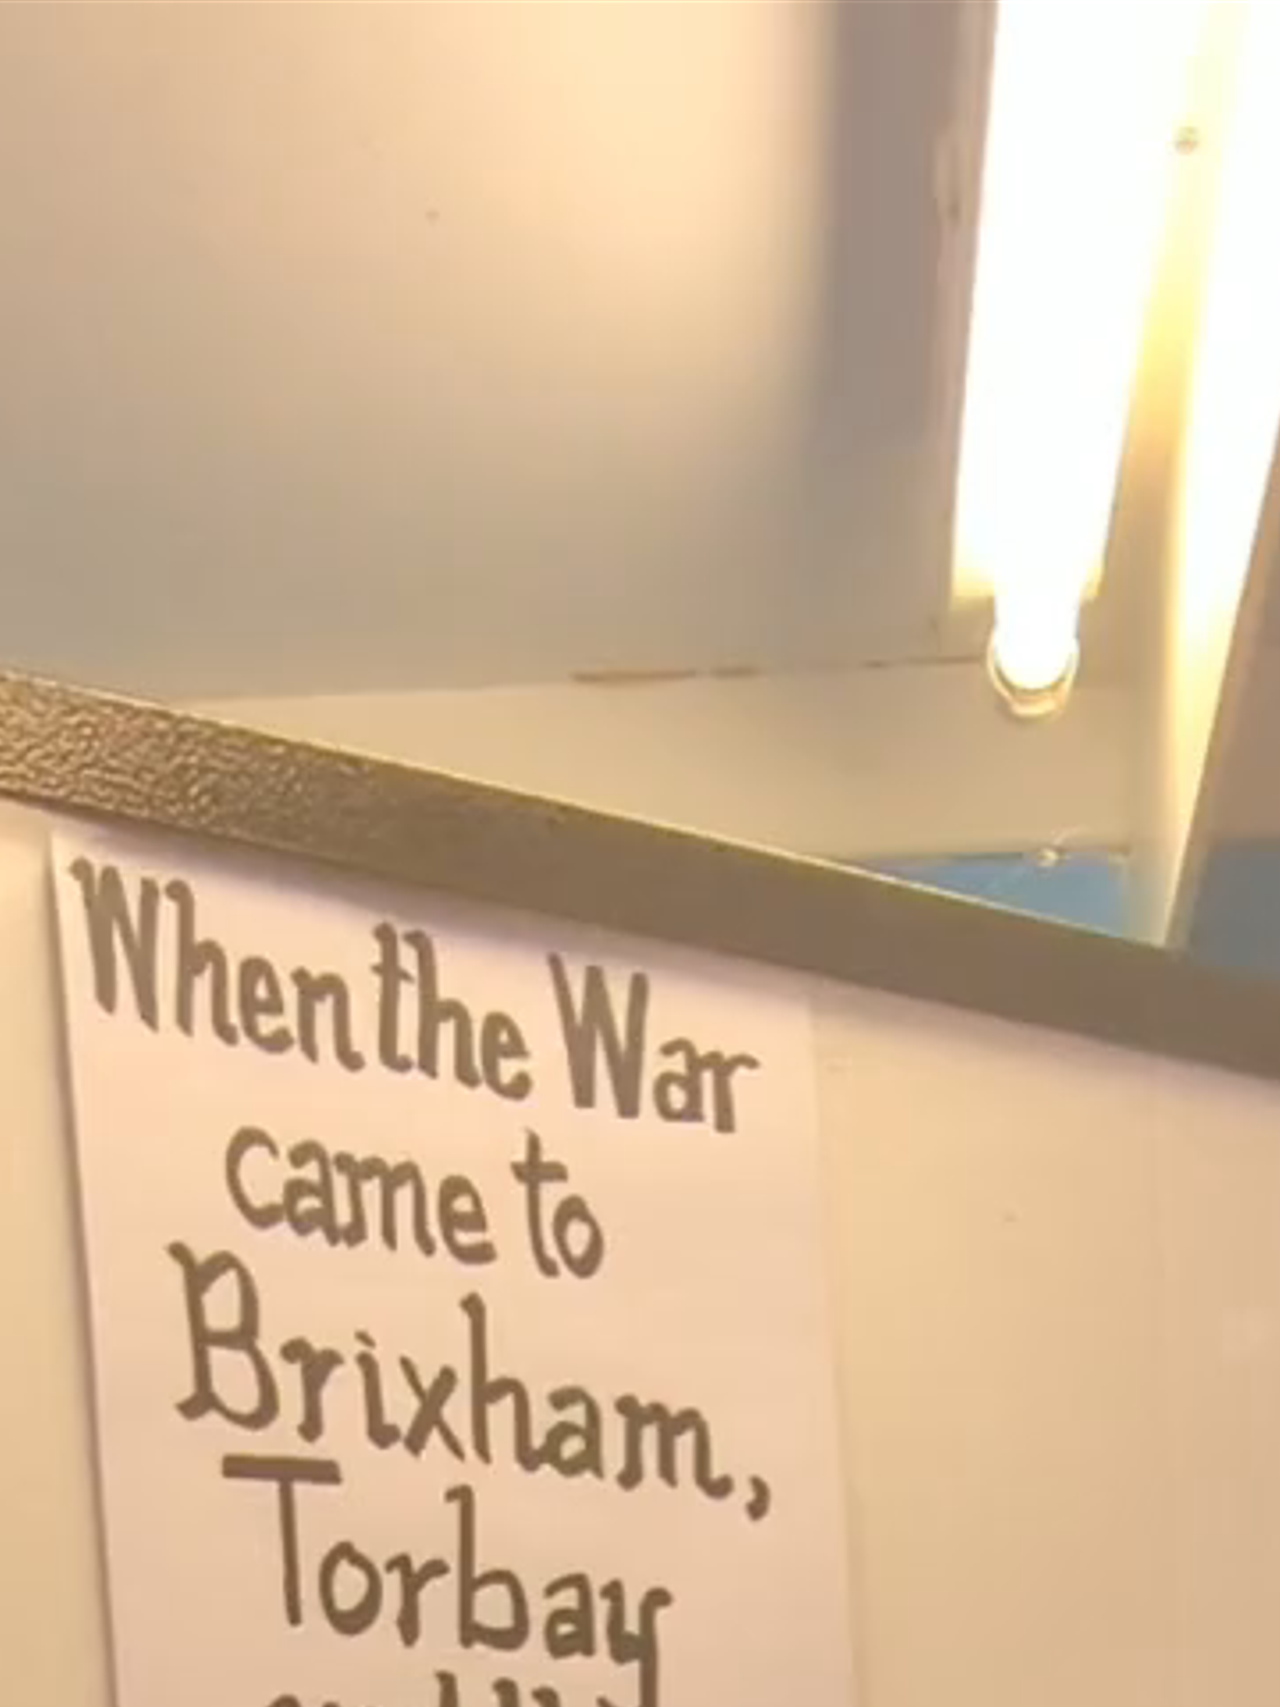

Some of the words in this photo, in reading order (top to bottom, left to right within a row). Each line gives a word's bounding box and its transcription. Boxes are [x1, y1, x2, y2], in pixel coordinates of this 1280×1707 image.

[66, 853, 367, 1074] When
[370, 923, 533, 1102] the
[547, 951, 761, 1134] War
[223, 1125, 498, 1266] came
[510, 1128, 605, 1280] to
[165, 1240, 772, 1522] Brixham,
